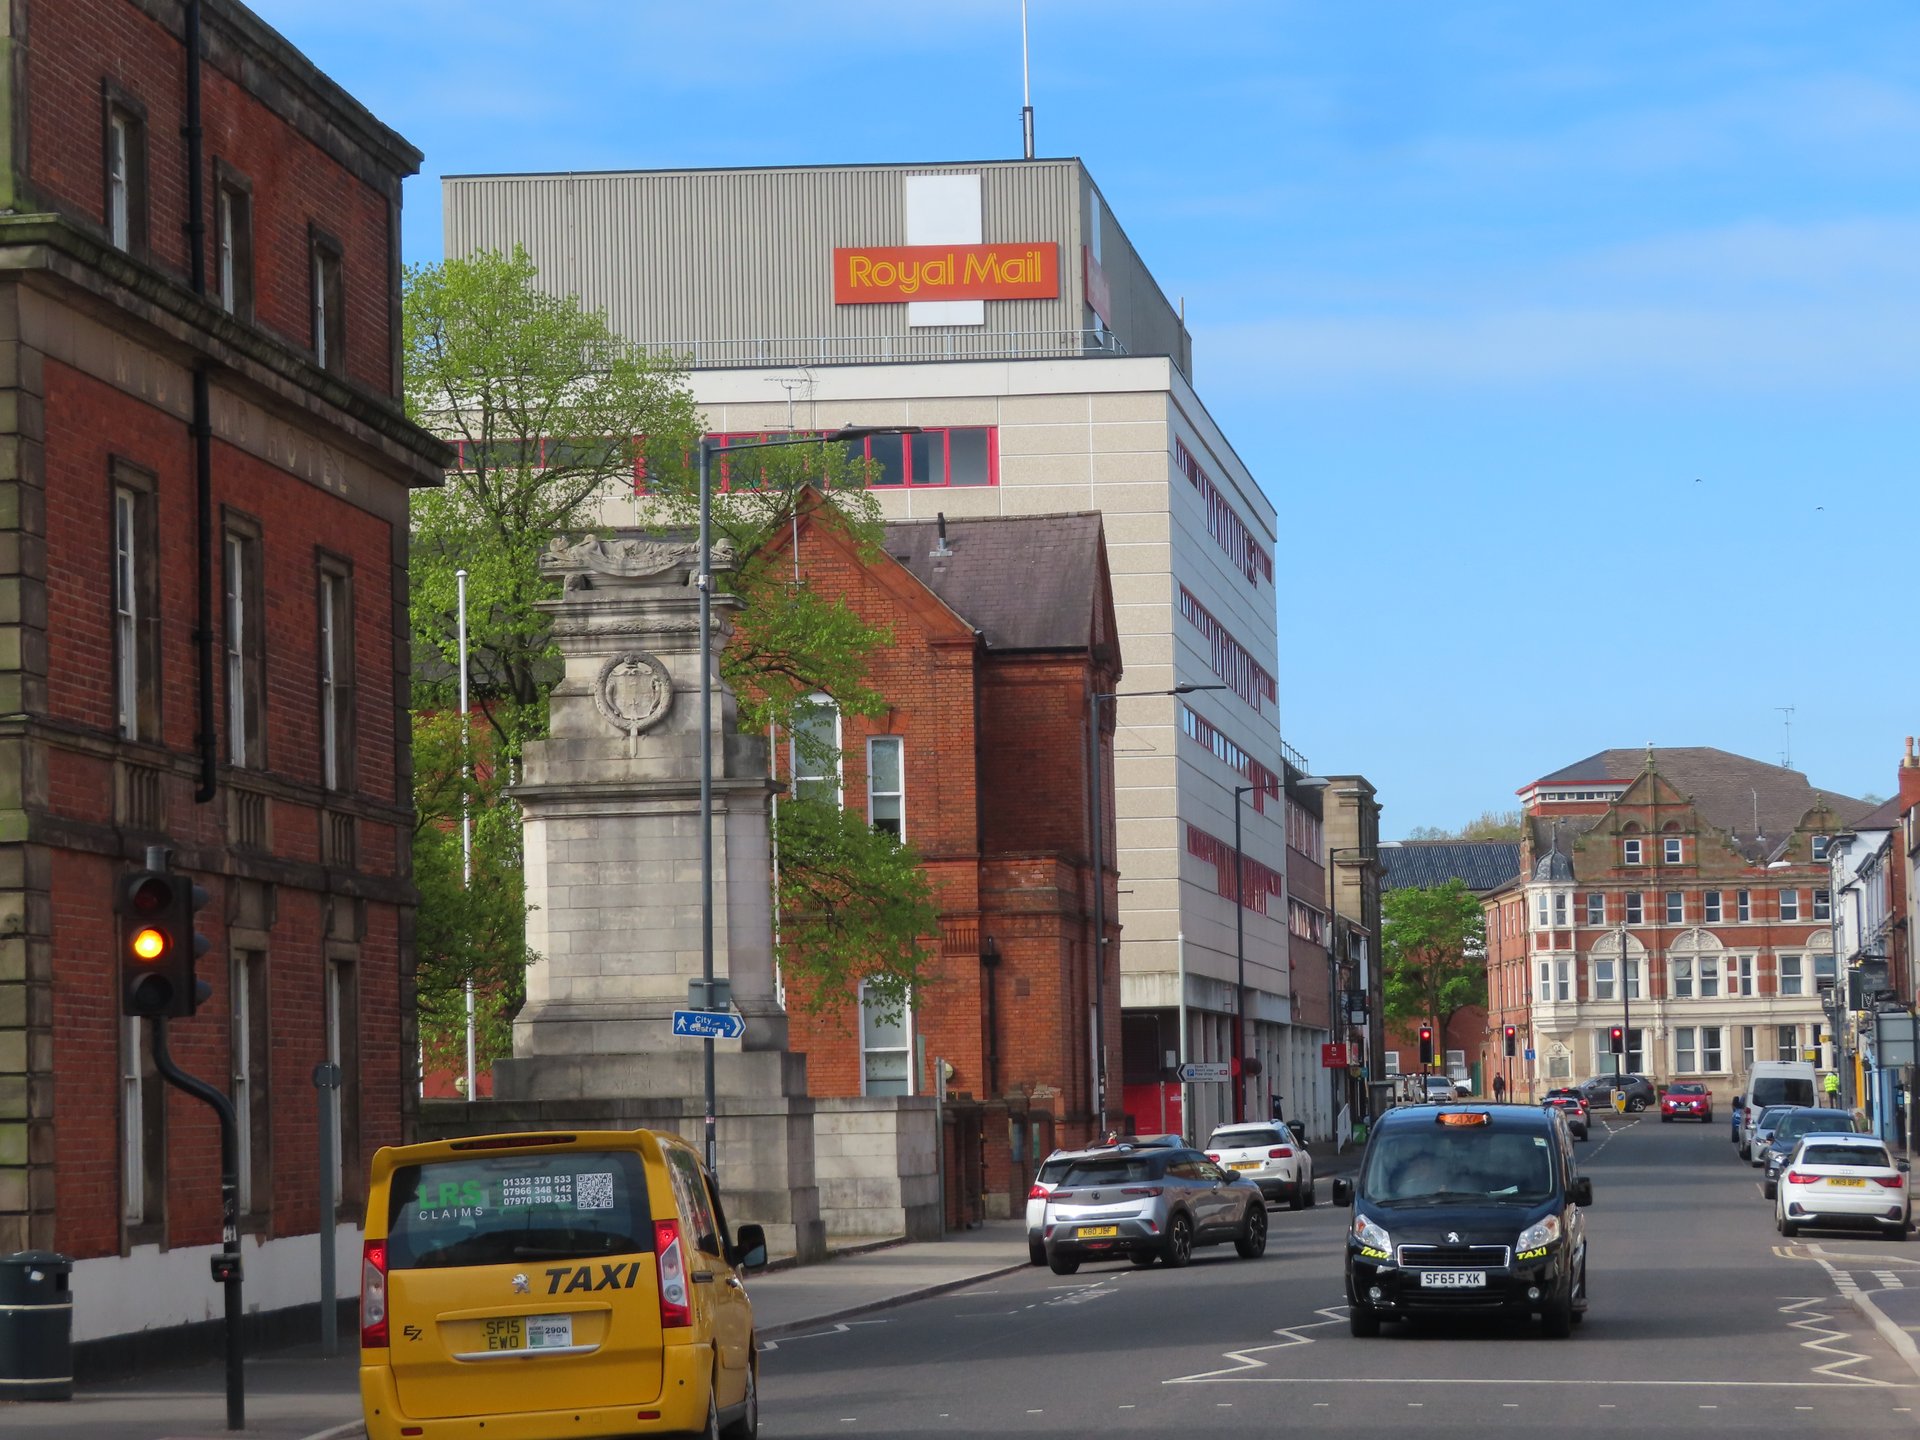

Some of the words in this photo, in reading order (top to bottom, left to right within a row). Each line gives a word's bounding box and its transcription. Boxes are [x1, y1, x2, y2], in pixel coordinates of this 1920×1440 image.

[849, 253, 954, 294] Royal
[963, 251, 1041, 285] Mail
[695, 1015, 712, 1025] City
[502, 1177, 532, 1187] 01332
[534, 1176, 552, 1185] 370
[554, 1175, 572, 1184] 533
[418, 1180, 482, 1210] LRS
[503, 1187, 532, 1196] 07966
[534, 1186, 552, 1194] 348
[554, 1184, 572, 1193] 142
[503, 1196, 533, 1206] 07970
[535, 1195, 552, 1204] 330
[554, 1194, 573, 1203] 233
[419, 1206, 483, 1221] CLAIMS
[1360, 1245, 1390, 1259] TAXI
[1516, 1246, 1547, 1260] TAXI
[545, 1262, 641, 1295] TAXI
[1425, 1273, 1455, 1284] SF65
[1457, 1273, 1480, 1284] FXK
[486, 1320, 520, 1335] SF15
[545, 1326, 567, 1335] 2900
